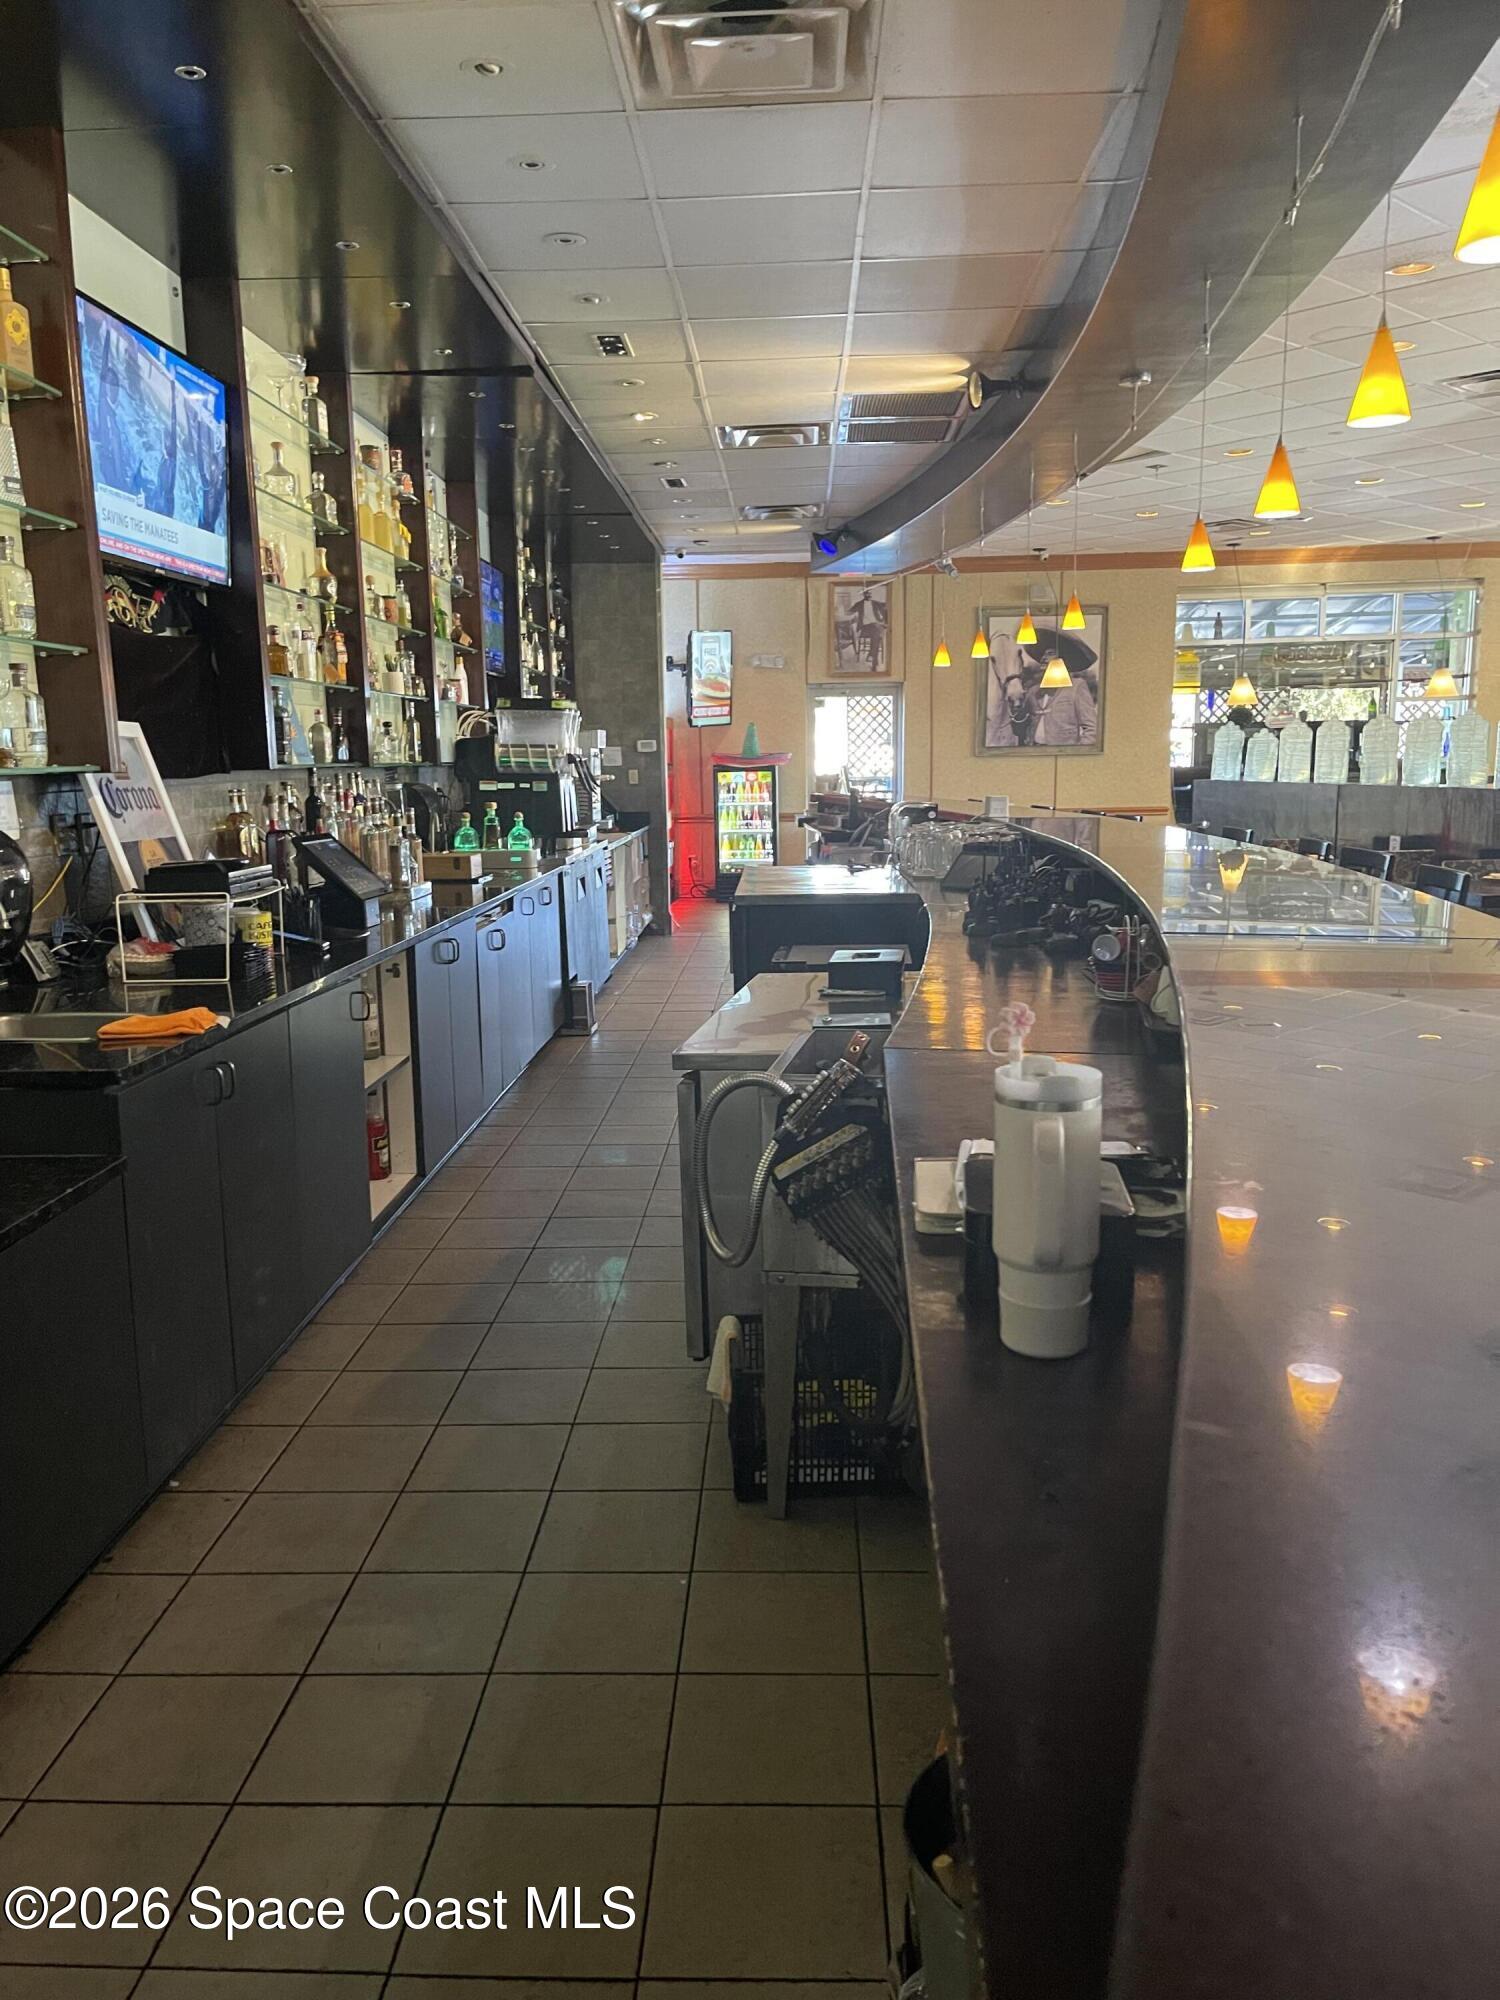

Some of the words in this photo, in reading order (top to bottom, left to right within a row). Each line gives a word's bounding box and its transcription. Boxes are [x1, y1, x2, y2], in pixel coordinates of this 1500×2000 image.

[102, 507, 129, 529] SAVING
[130, 516, 145, 534] THE
[145, 522, 179, 545] MANATEES
[99, 776, 162, 821] Corona
